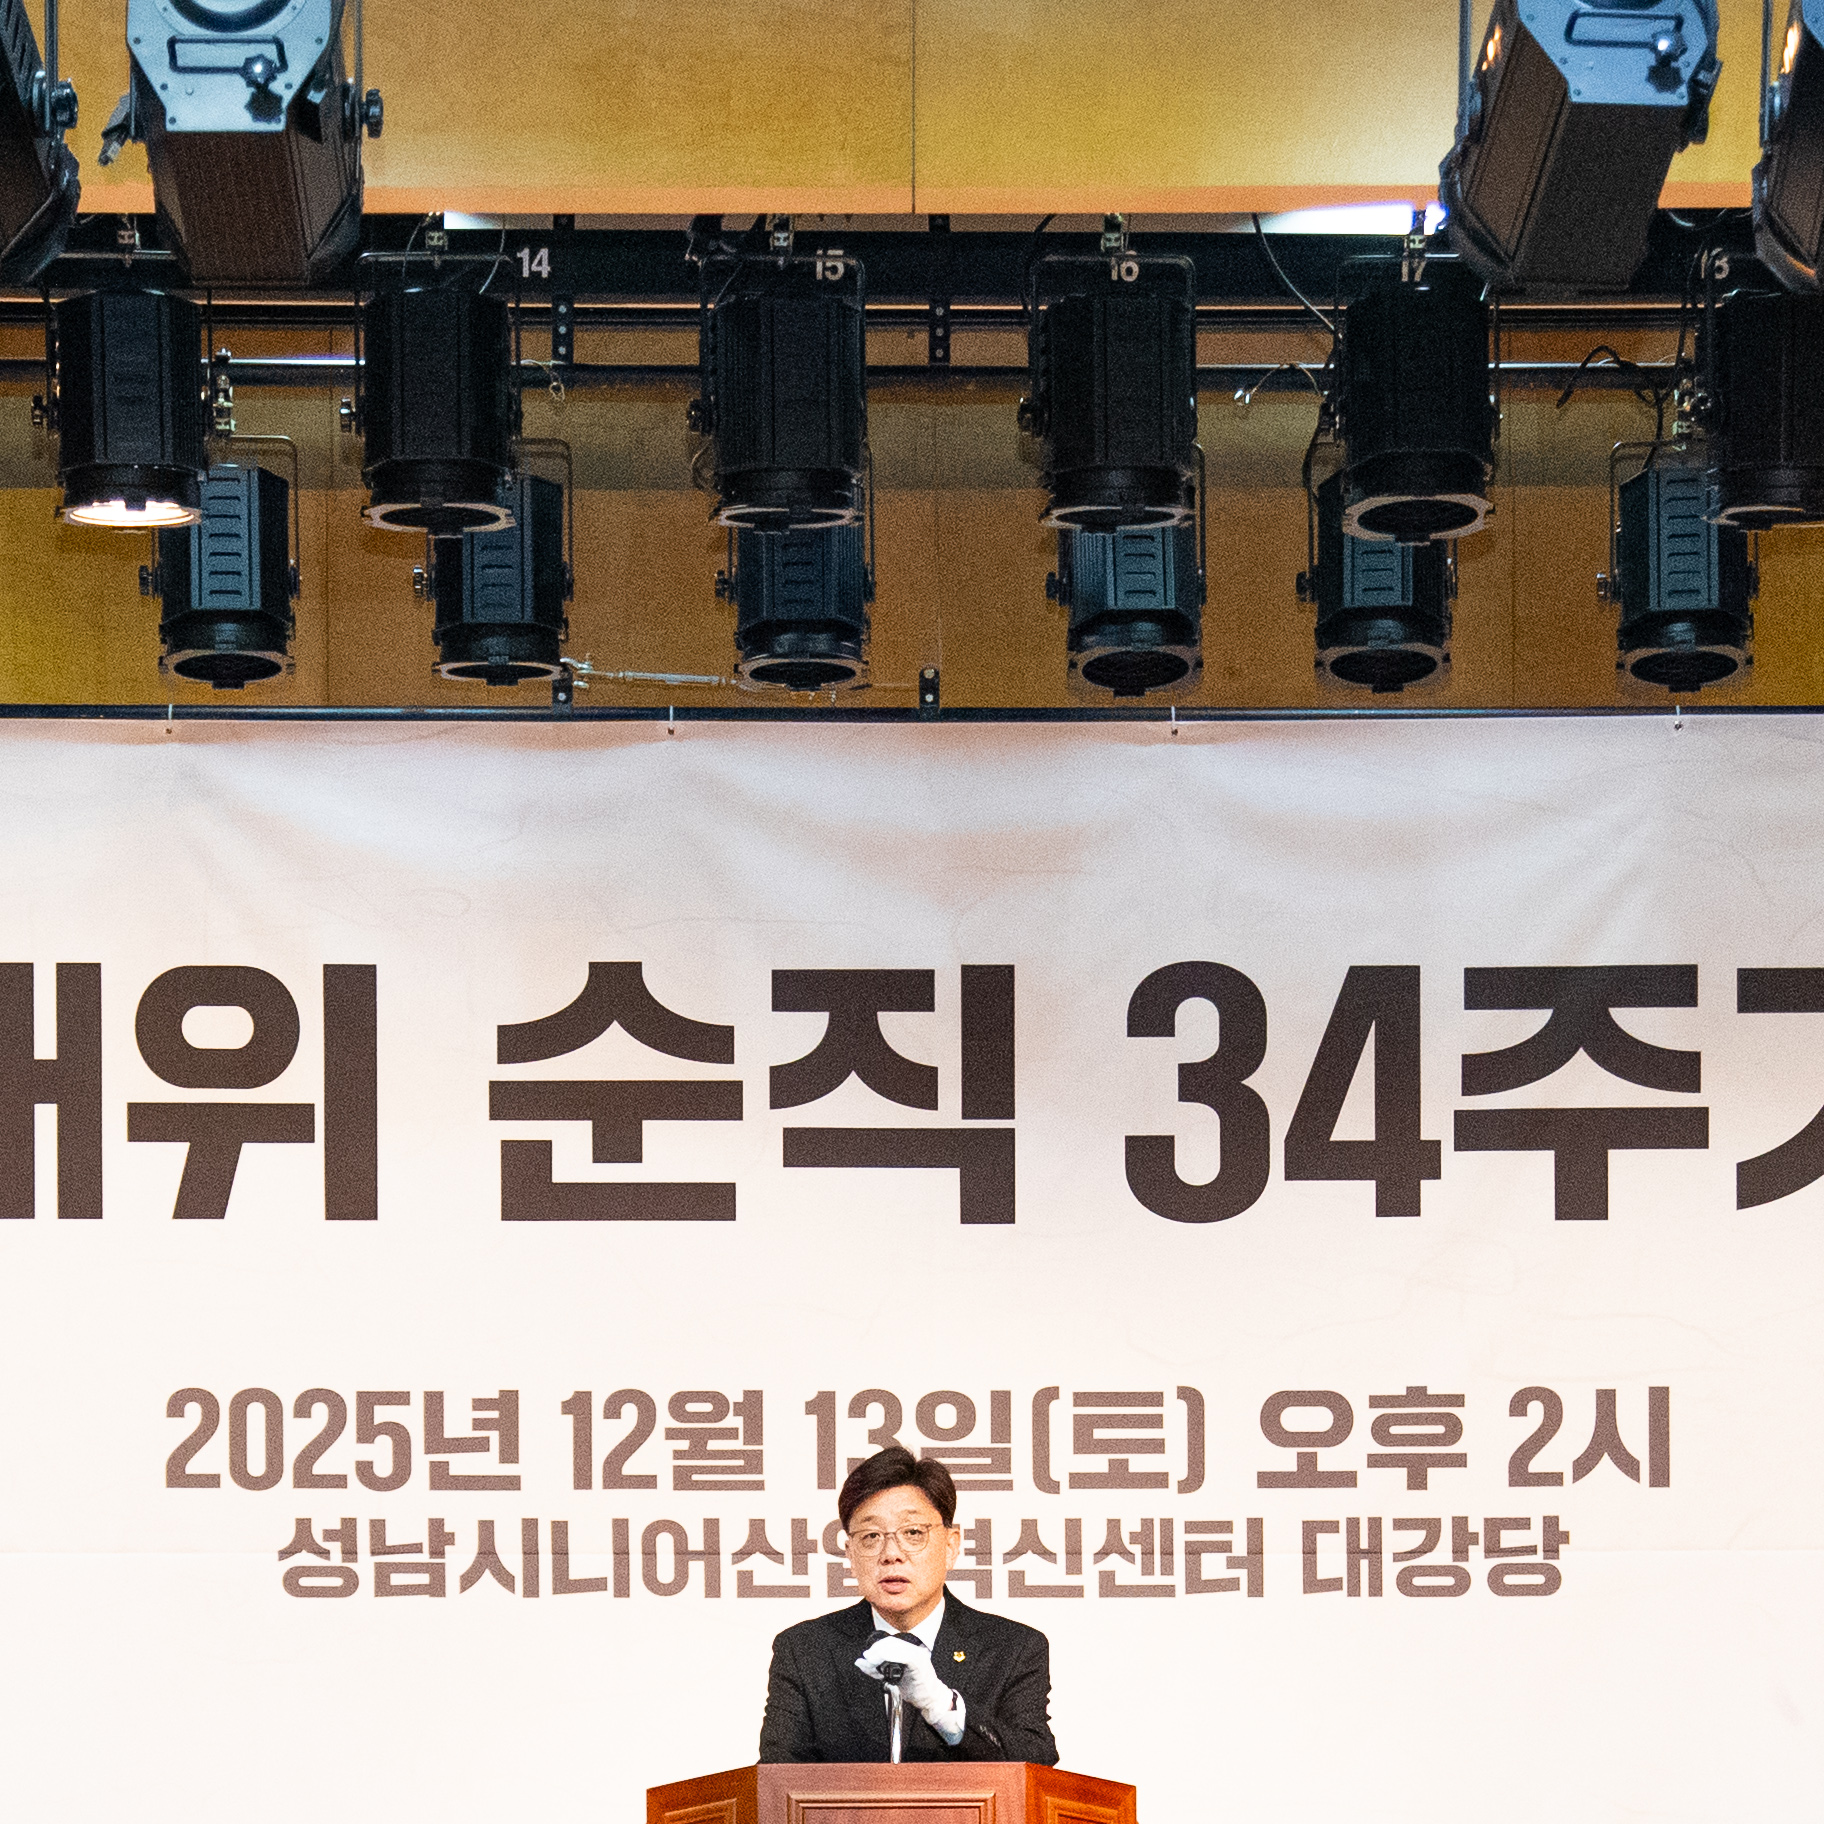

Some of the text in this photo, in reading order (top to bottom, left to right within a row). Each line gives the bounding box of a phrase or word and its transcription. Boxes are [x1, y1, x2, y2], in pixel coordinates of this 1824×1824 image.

[516, 247, 552, 279] 14
[815, 248, 846, 281] 15
[1110, 250, 1140, 282] 16
[490, 962, 1014, 1223] 순직
[166, 1386, 1670, 1494] 2025년 12월 13일(토) 오후 2시
[1302, 1516, 1569, 1597] 대강당
